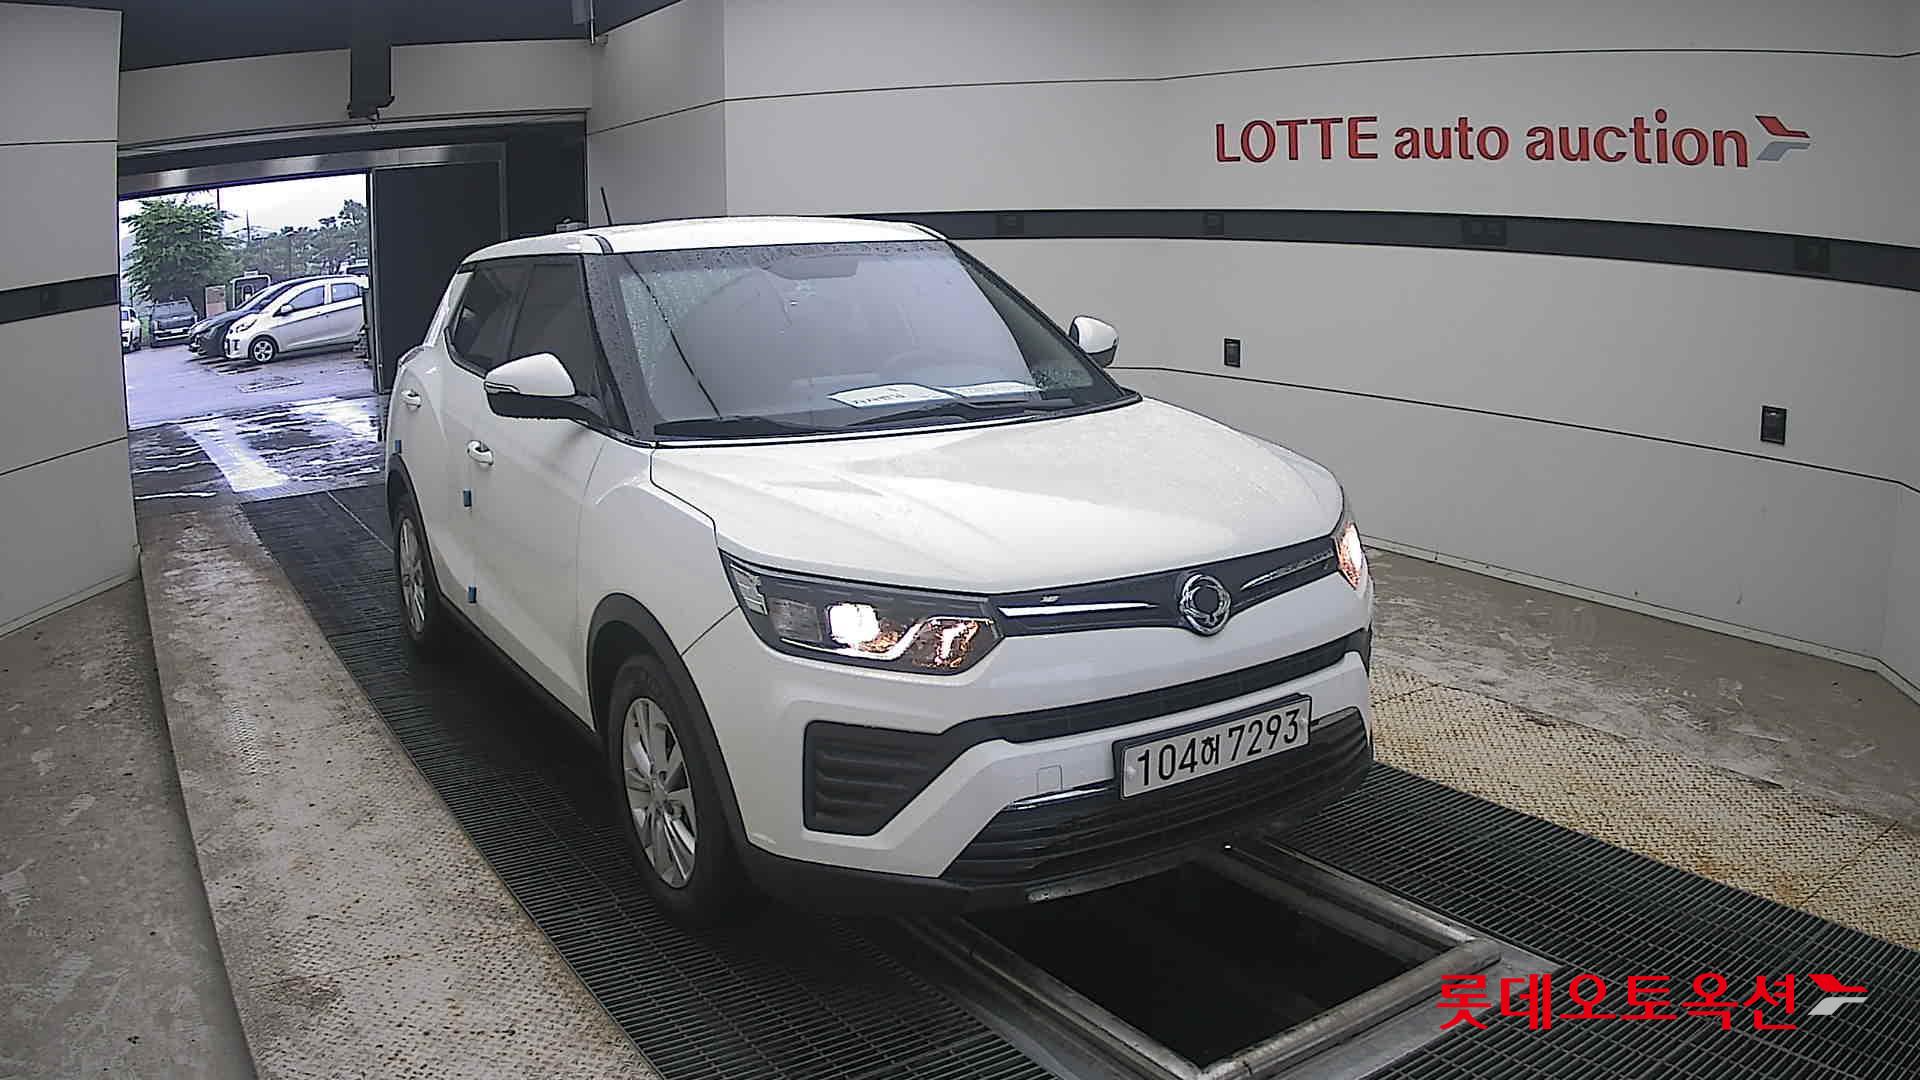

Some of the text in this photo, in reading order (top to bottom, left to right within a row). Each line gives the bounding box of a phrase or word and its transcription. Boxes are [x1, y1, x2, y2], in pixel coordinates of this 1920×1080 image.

[1216, 109, 1748, 168] LOTTE auto auction
[1137, 708, 1301, 786] 104허 7293
